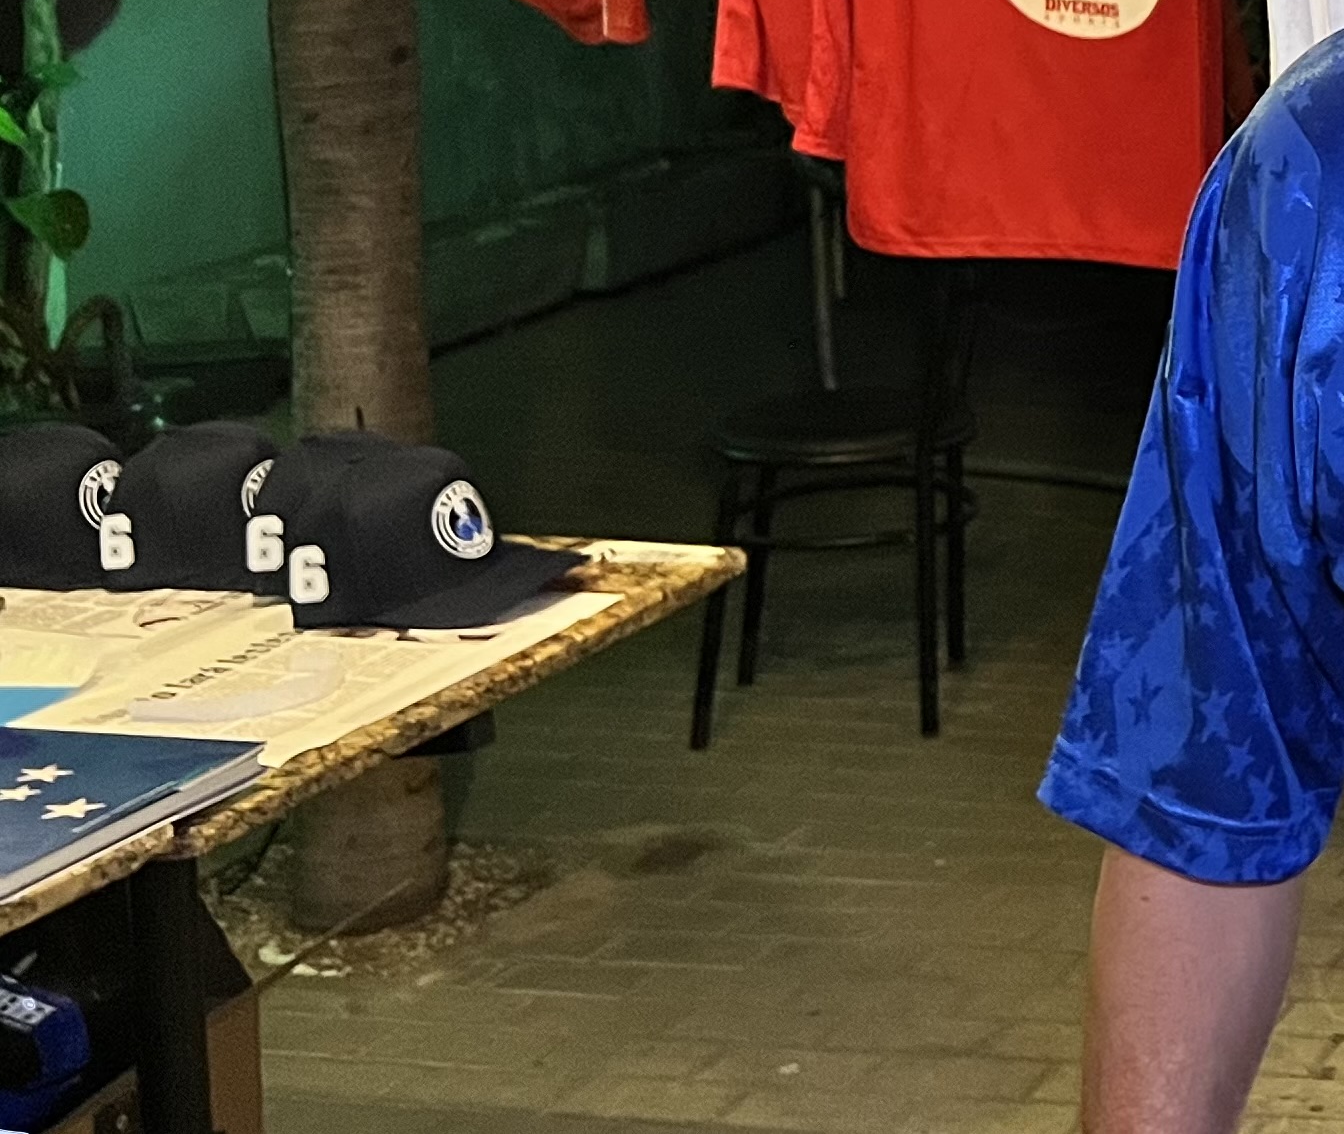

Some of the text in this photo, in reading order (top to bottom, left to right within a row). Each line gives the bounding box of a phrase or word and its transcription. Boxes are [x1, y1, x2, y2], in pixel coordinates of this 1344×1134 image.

[100, 513, 135, 571] 6
[246, 514, 284, 572] 6
[289, 545, 329, 604] 6
